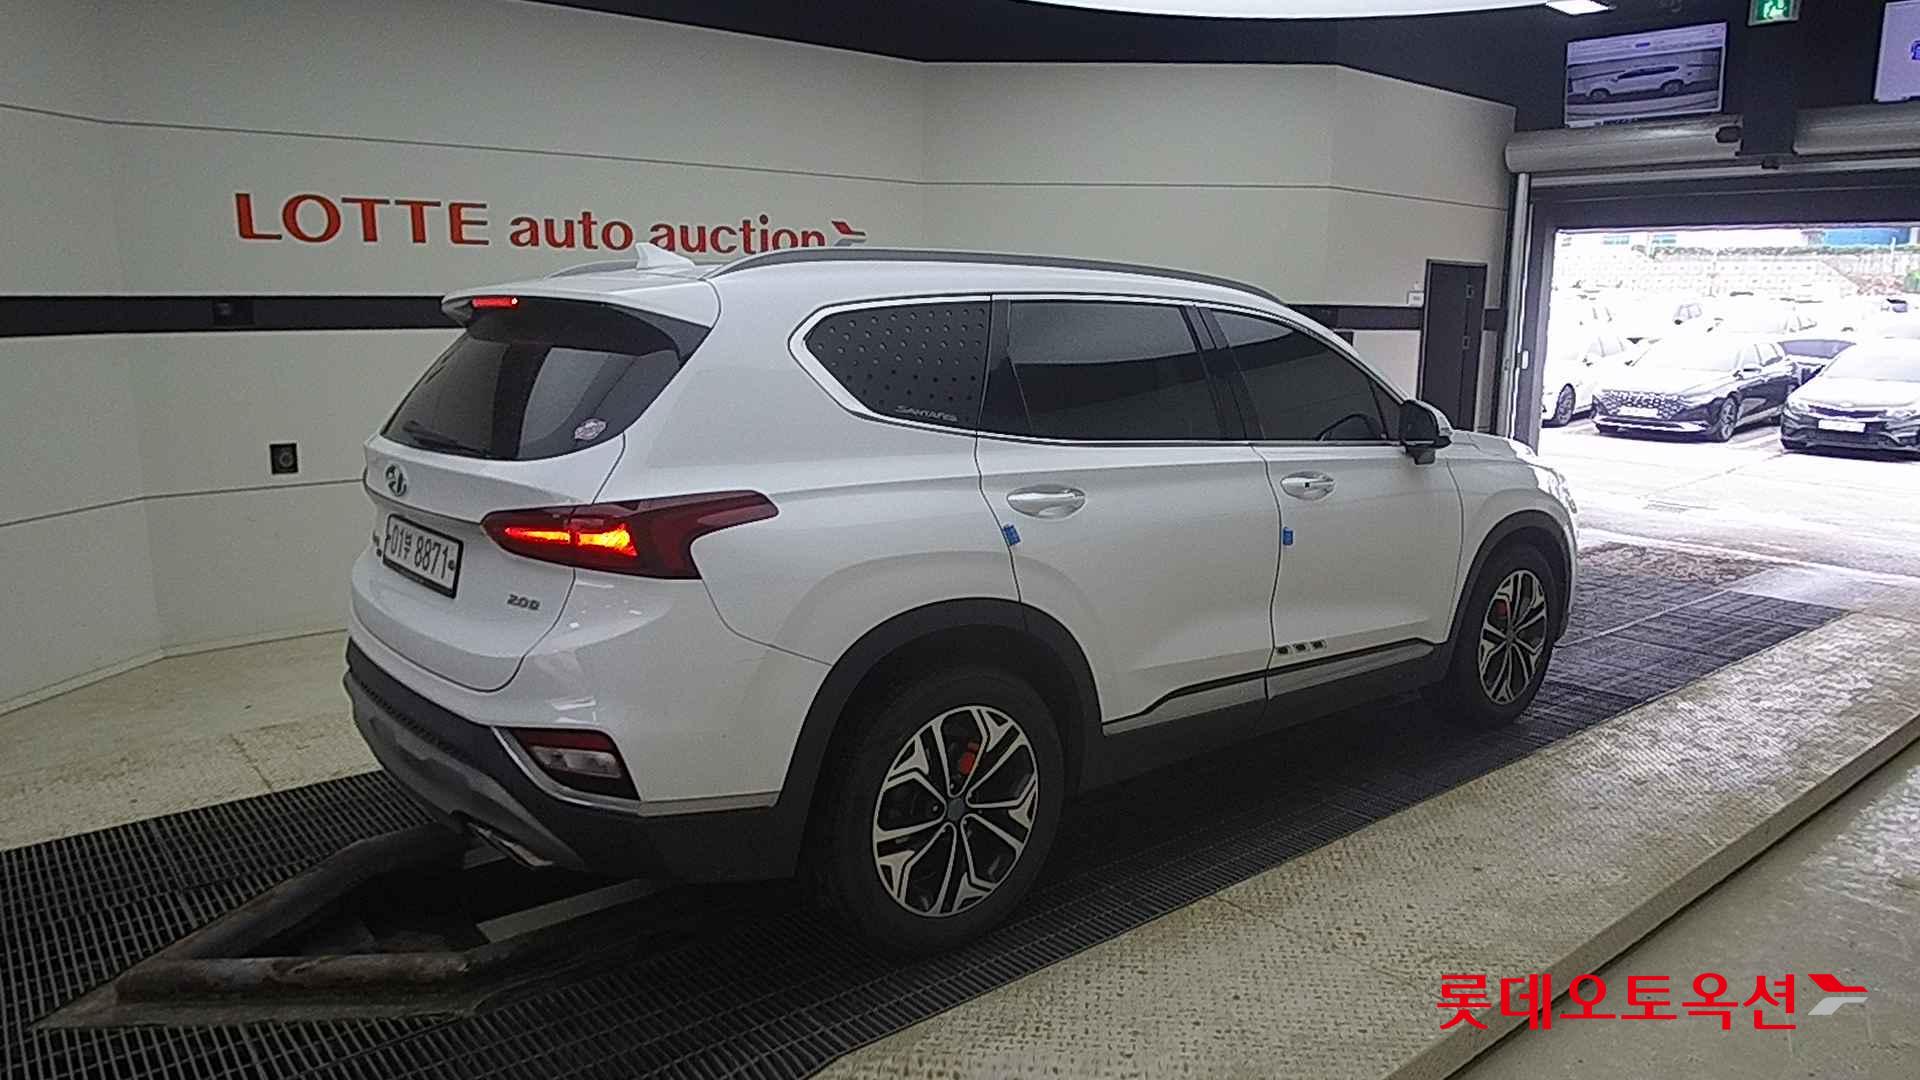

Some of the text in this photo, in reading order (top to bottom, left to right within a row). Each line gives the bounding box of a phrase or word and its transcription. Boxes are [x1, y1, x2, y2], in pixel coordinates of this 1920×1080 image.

[235, 192, 826, 255] LOTTE auto auction
[414, 535, 449, 580] 8871
